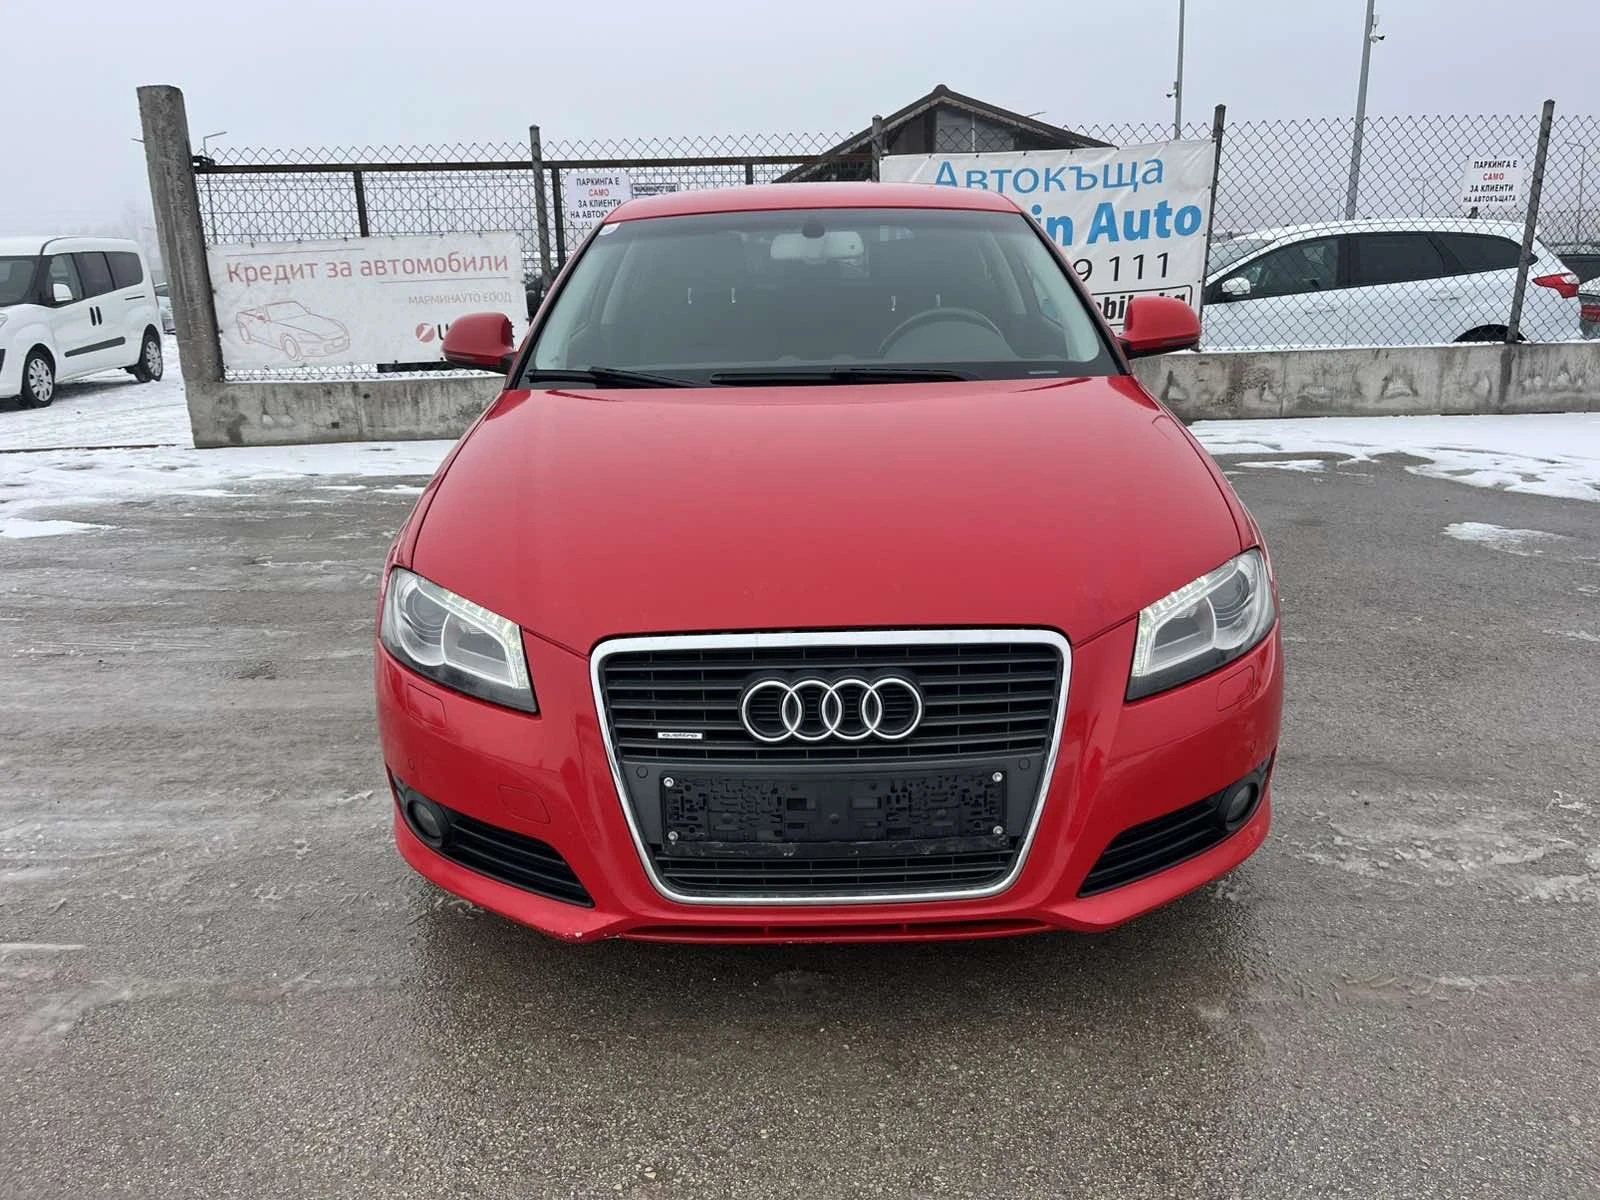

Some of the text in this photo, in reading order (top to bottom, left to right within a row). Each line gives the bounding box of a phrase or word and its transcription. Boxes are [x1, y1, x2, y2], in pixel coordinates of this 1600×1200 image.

[1474, 160, 1517, 169] ПАРКИНГА Е
[935, 158, 1164, 194] Автокъща
[1483, 173, 1504, 181] САМО
[576, 177, 620, 186] ПАРКИНГА Е
[1470, 184, 1514, 192] ЗА КЛИЕНТИ
[578, 199, 621, 208] ЗА КЛИЕНТИ
[1473, 195, 1516, 203] АВТОКЪЩАТА
[570, 211, 581, 219] НА
[1087, 200, 1203, 244] Auto
[226, 251, 510, 287] Кредит за автомобили
